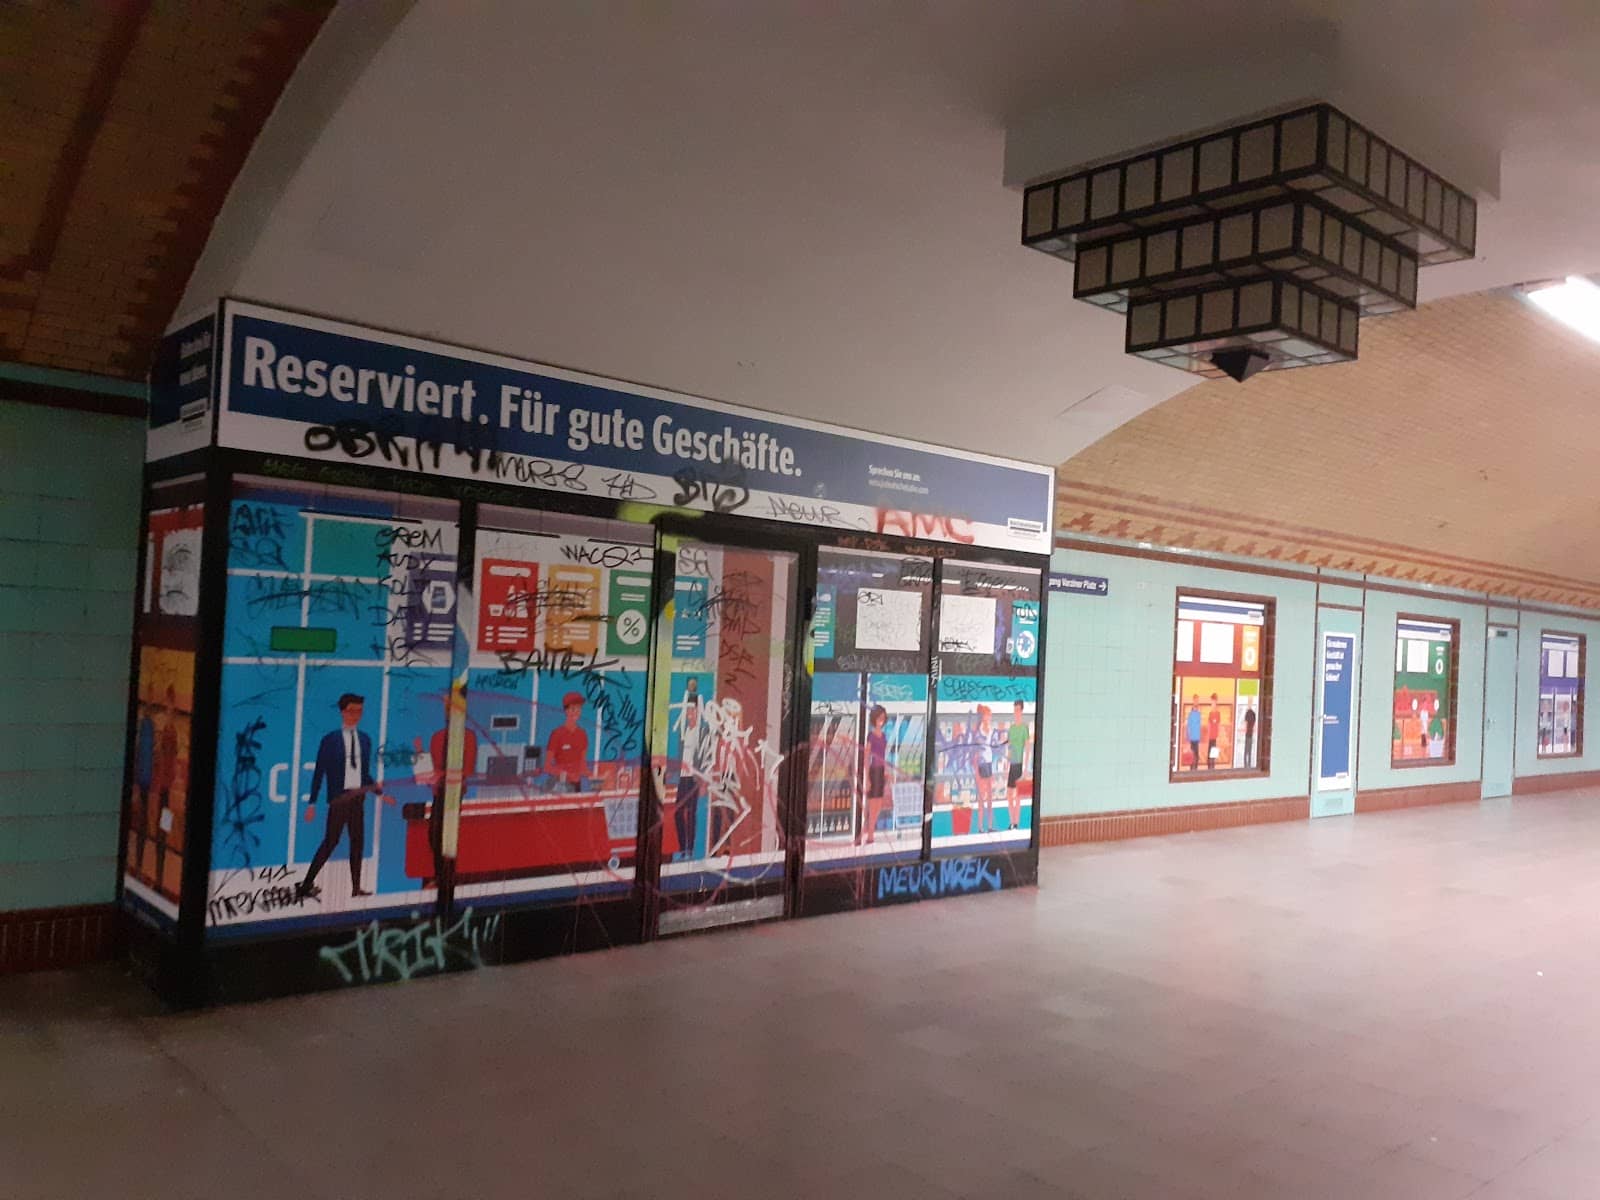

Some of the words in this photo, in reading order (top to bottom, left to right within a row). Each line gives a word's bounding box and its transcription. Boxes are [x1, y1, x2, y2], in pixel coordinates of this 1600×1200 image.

[242, 335, 489, 425] Reserviert.
[500, 384, 560, 437] Für
[567, 408, 645, 452] gute
[652, 415, 803, 477] Geschäfte.
[876, 506, 976, 544] AMC
